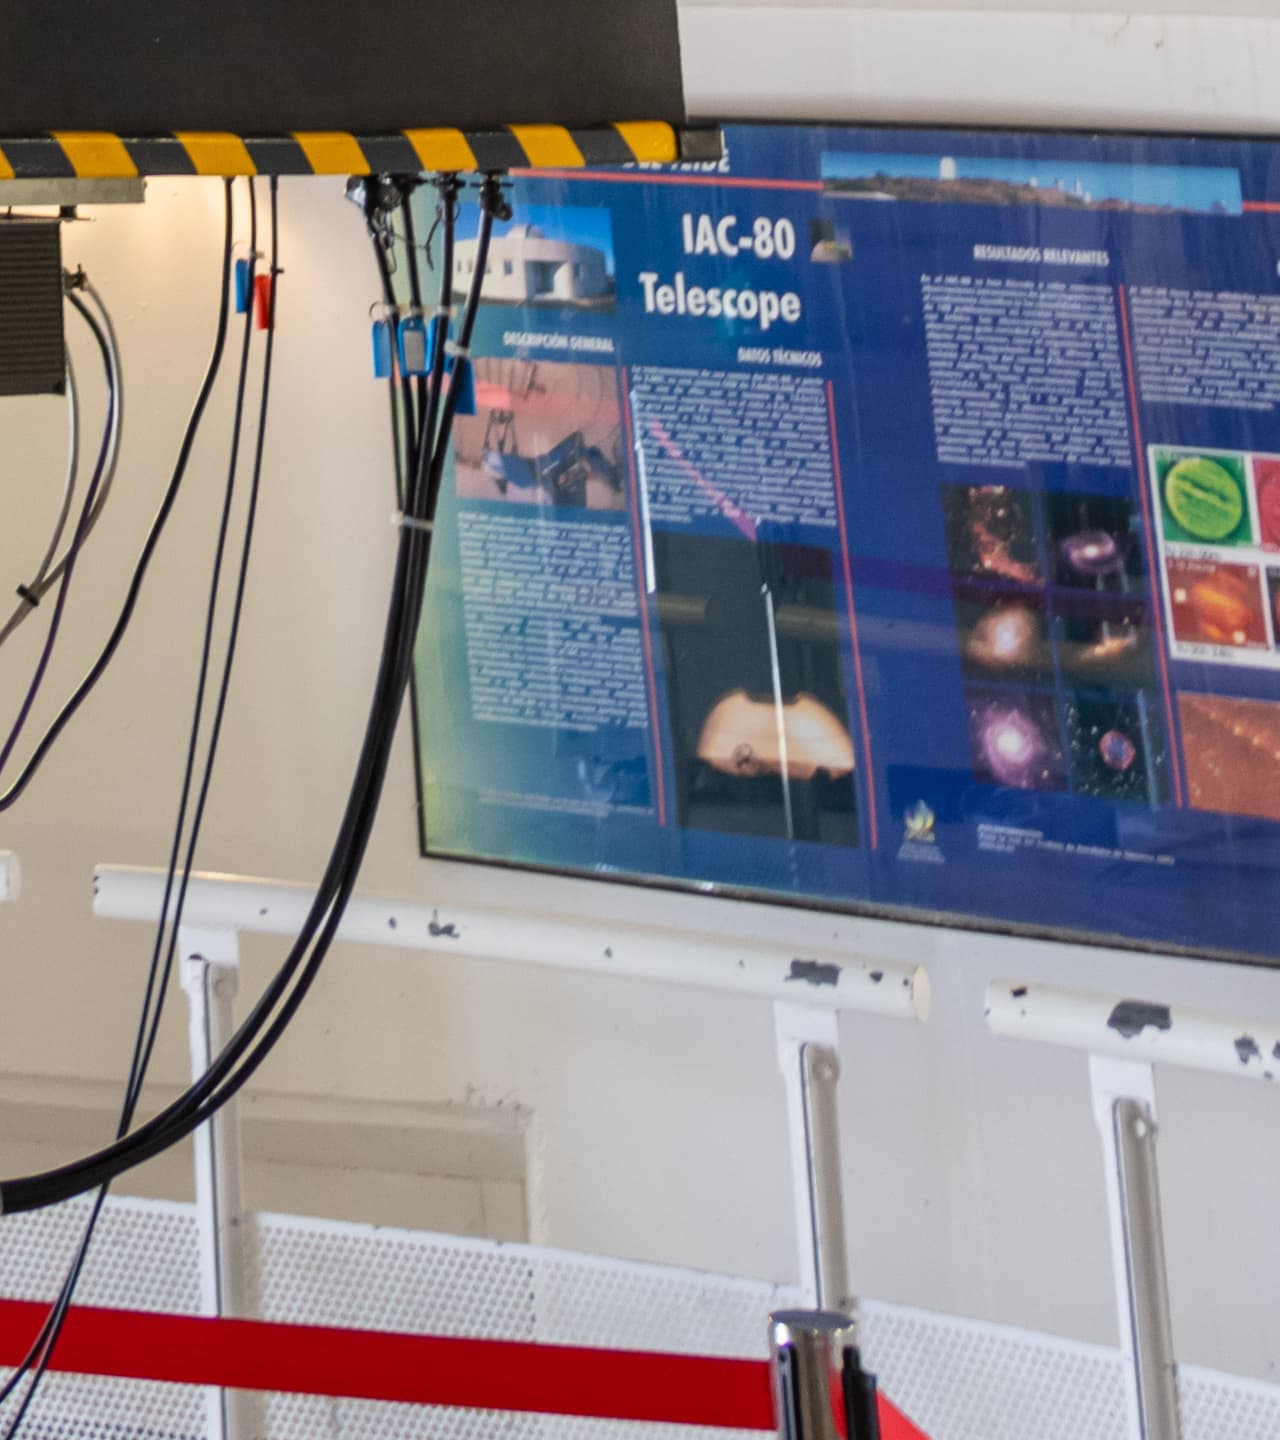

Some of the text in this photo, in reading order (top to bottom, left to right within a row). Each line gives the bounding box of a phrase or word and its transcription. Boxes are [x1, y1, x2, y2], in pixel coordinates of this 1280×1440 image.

[681, 212, 796, 261] IAC-80
[973, 243, 1111, 268] RESULTADOS RELEVANTES
[638, 272, 802, 331] Telescope
[569, 334, 615, 354] GENERAL
[737, 347, 771, 366] DATOS
